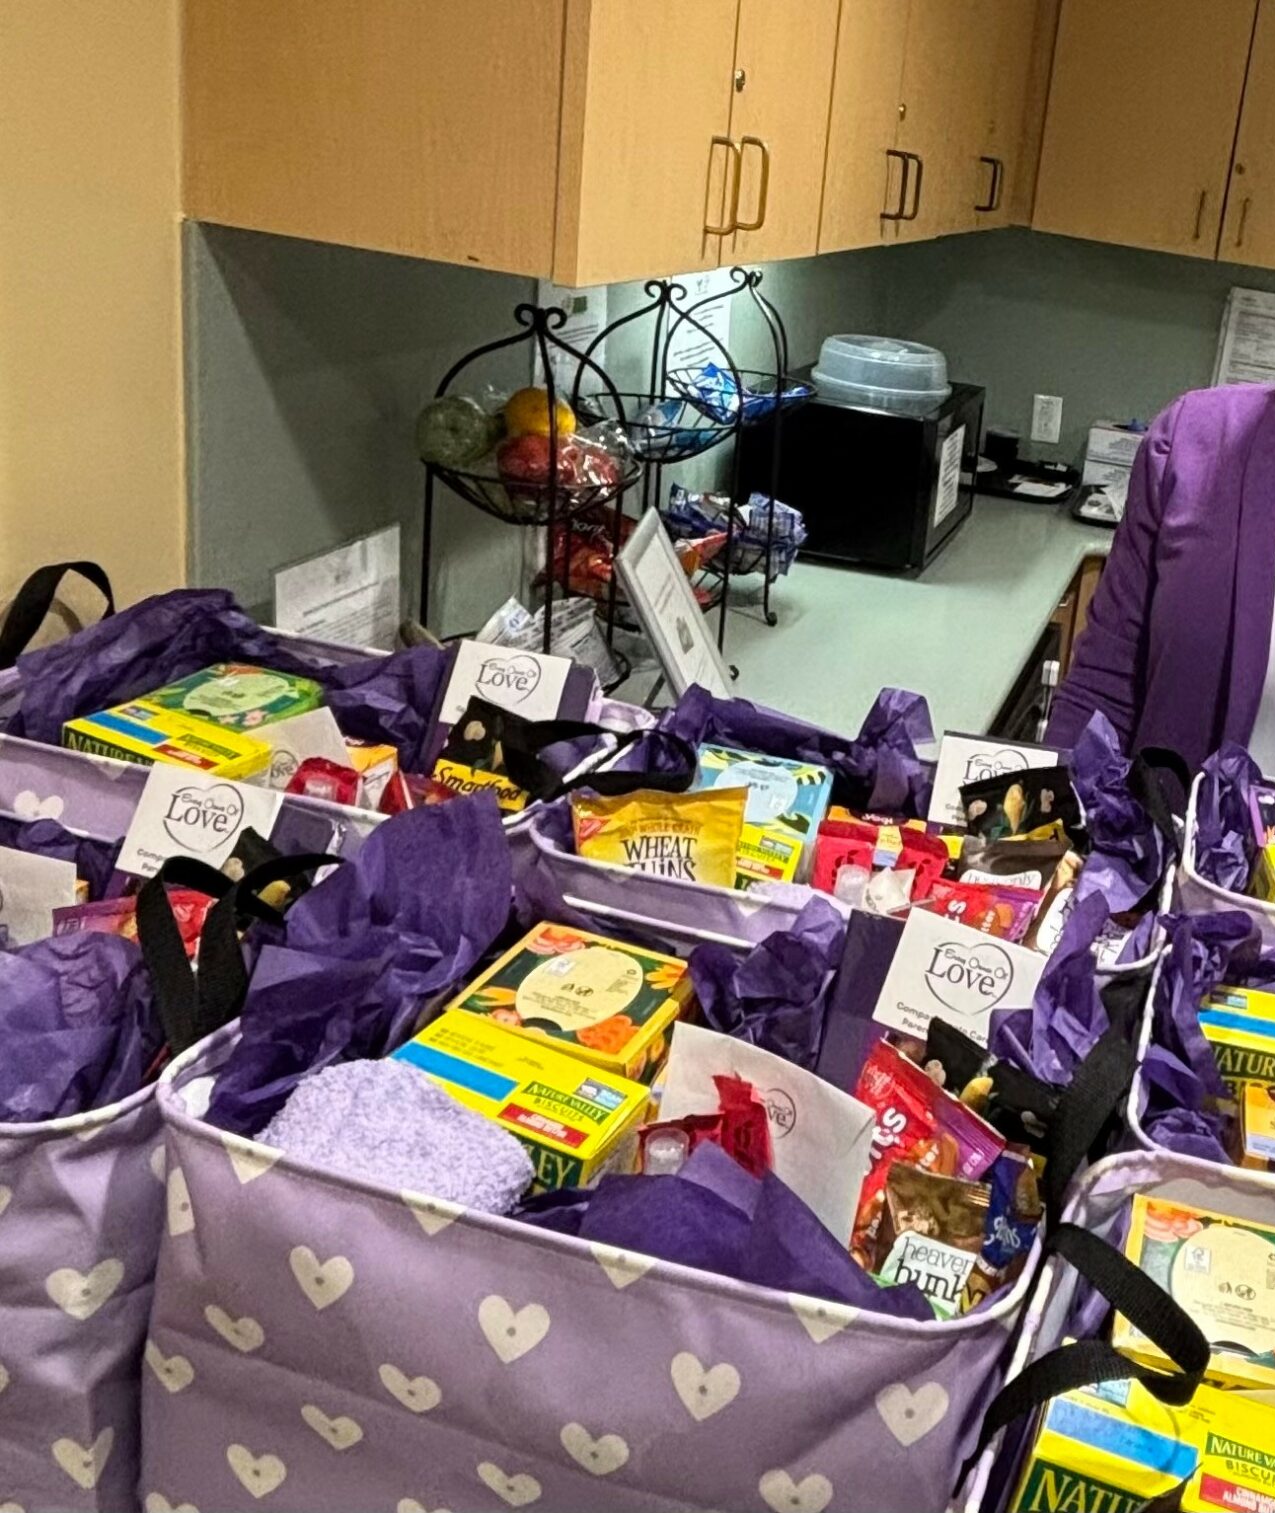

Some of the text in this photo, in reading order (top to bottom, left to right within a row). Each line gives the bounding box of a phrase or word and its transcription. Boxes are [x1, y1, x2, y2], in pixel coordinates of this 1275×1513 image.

[477, 664, 528, 691] Love
[164, 794, 228, 832] Love
[620, 835, 699, 863] WHEAT
[925, 947, 996, 996] Love
[529, 1083, 607, 1121] NATURE VALLEY
[533, 1097, 586, 1123] BISCUITS
[1211, 1436, 1262, 1464] NATURE
